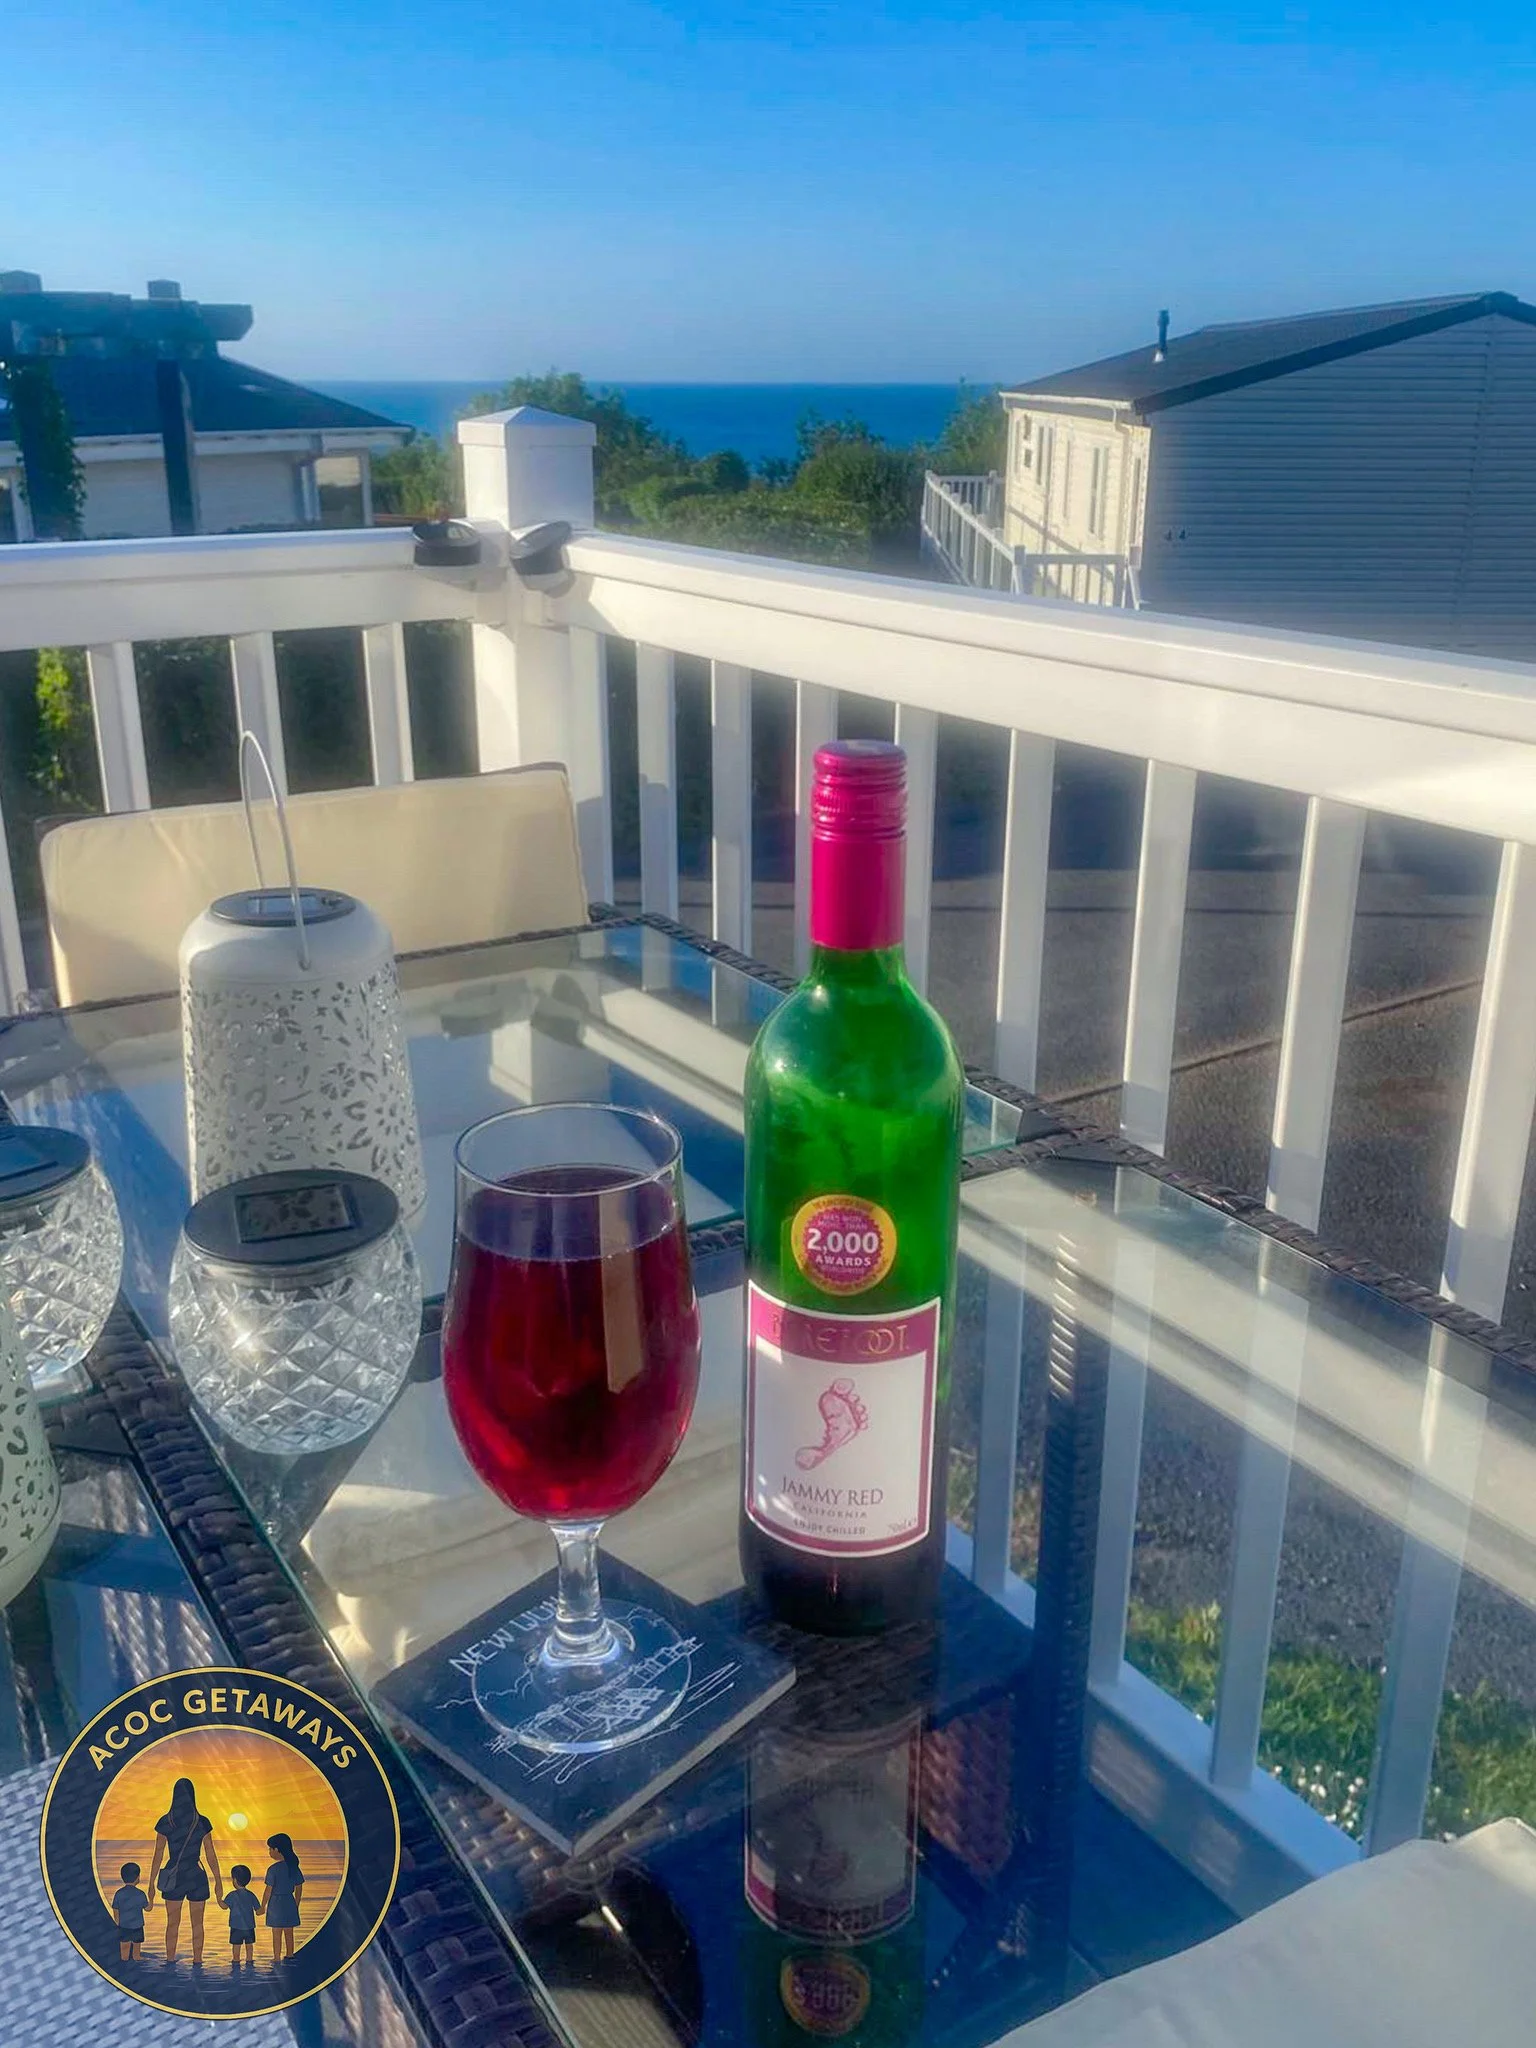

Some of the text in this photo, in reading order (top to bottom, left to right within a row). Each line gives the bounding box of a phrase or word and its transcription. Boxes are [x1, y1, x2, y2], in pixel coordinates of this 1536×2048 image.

[807, 1227, 879, 1254] 2,000
[815, 1254, 872, 1267] AWARDS
[782, 1475, 884, 1506] JAMMY RED
